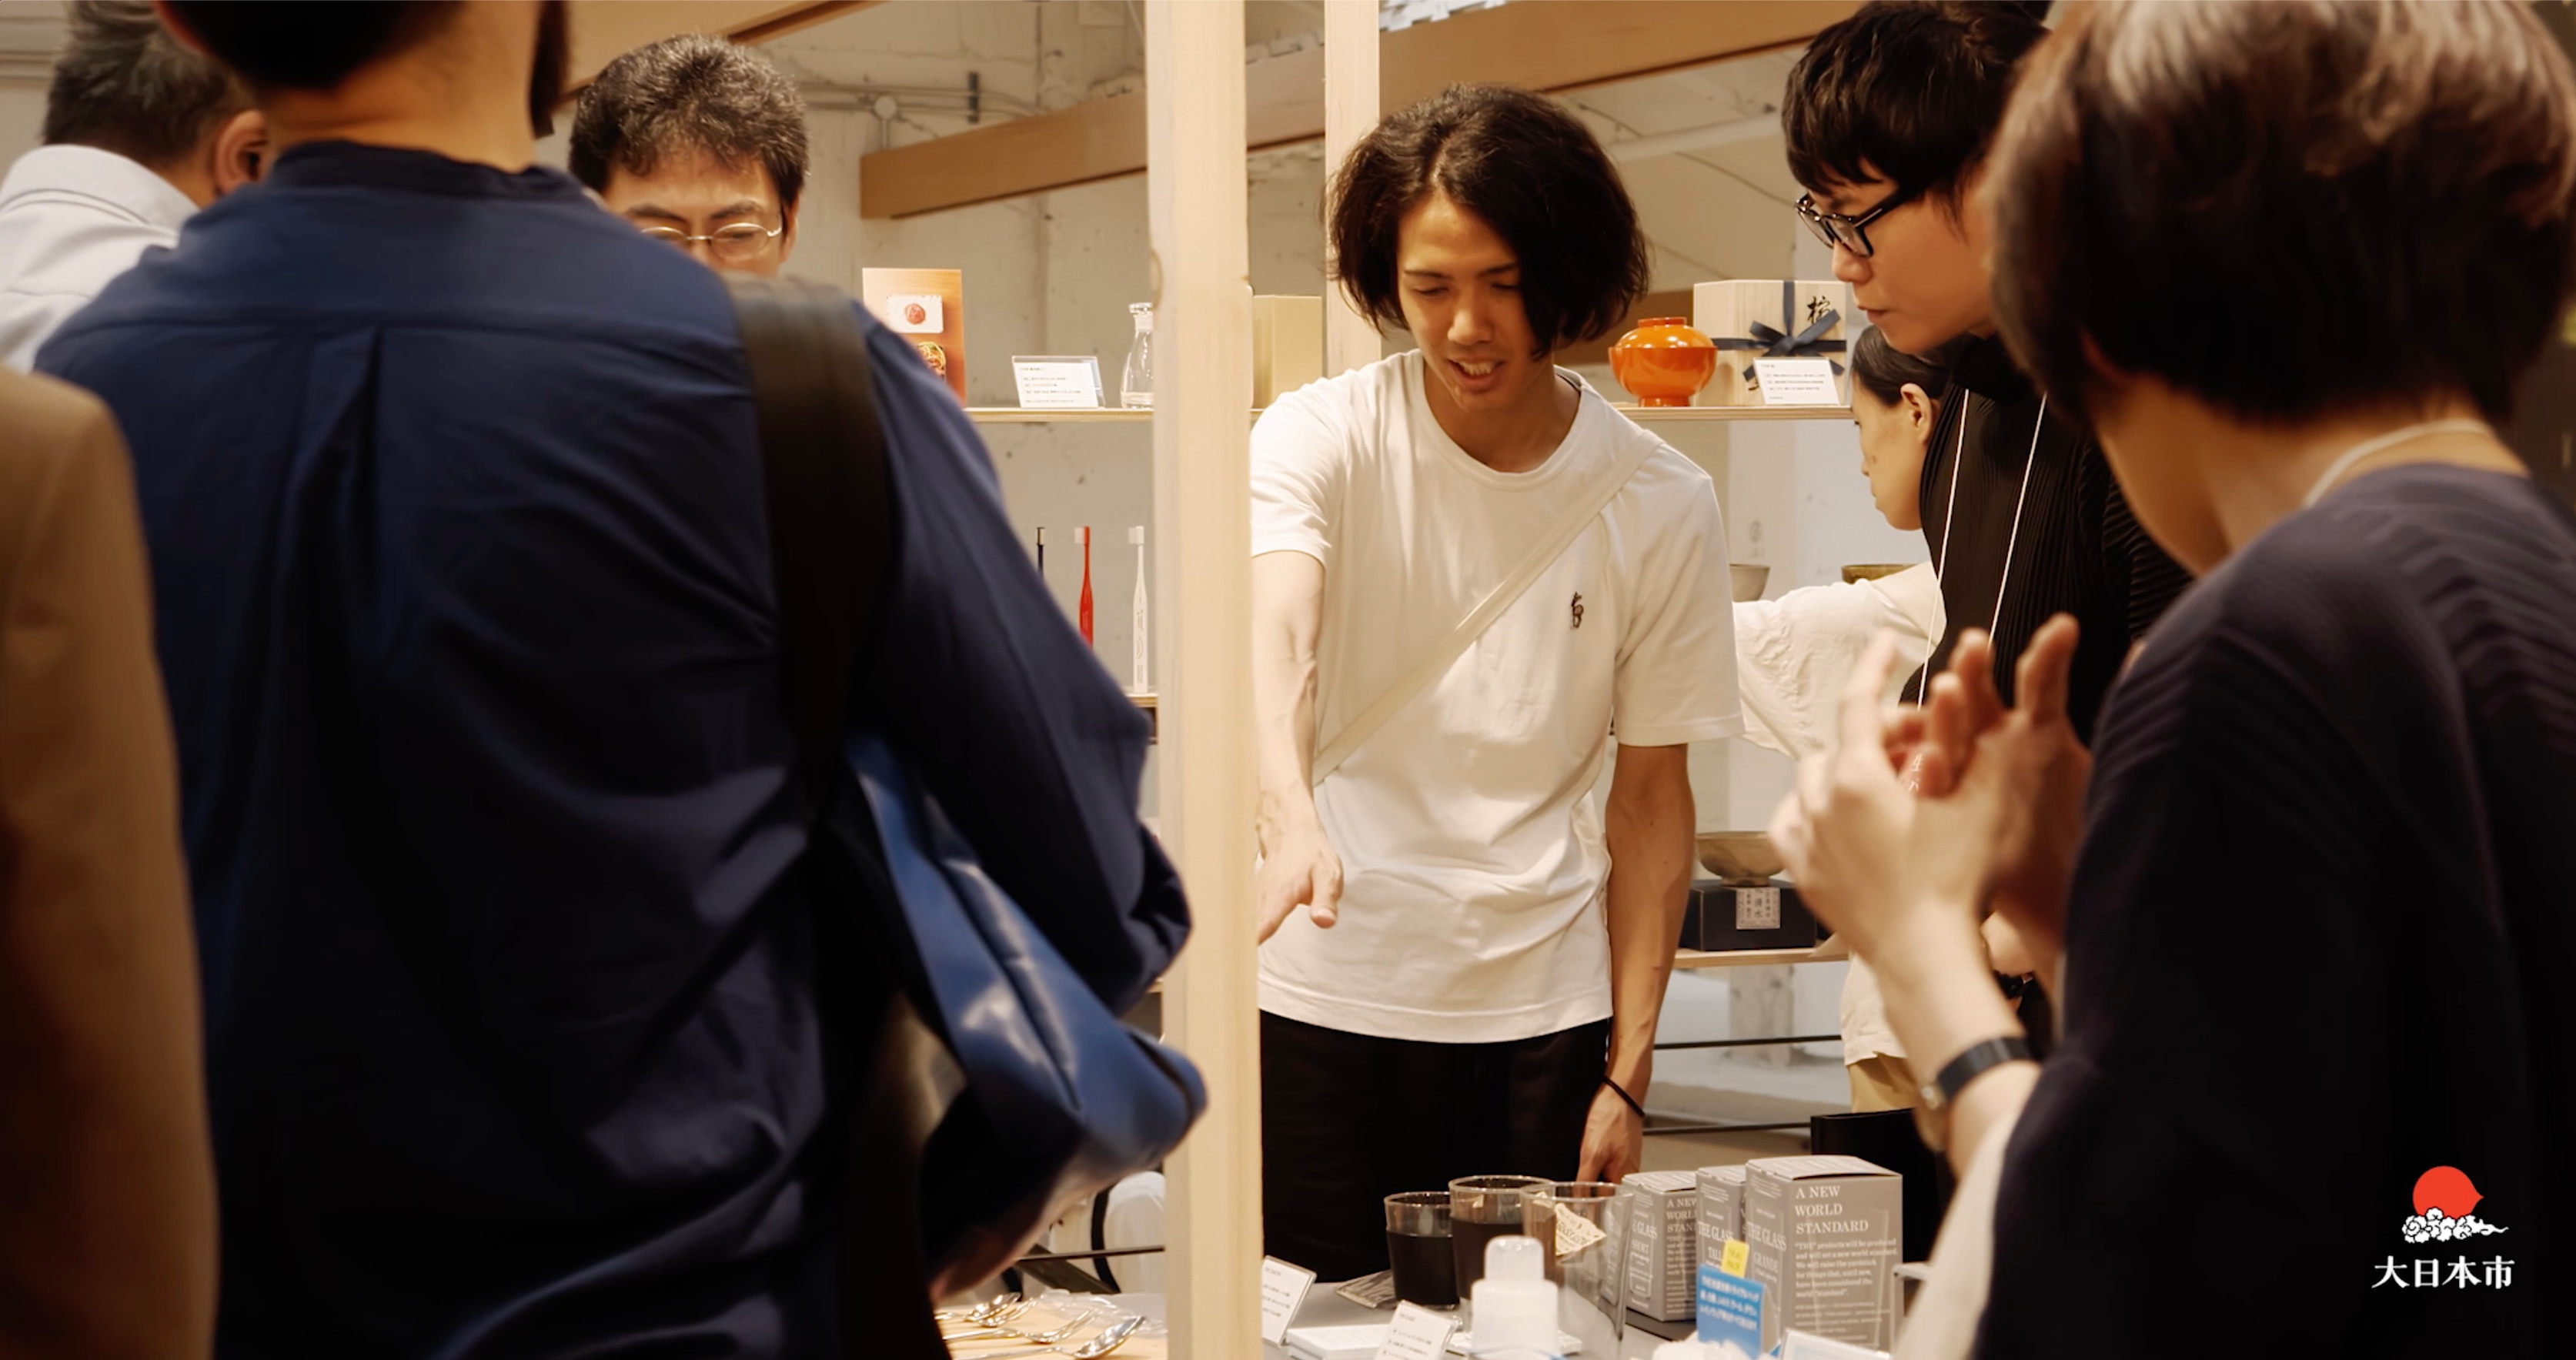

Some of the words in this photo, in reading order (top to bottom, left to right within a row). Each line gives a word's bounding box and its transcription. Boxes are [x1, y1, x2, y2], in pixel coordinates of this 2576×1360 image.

[1796, 1187, 1806, 1199] A
[1809, 1185, 1840, 1198] NEW
[1666, 1198, 1674, 1208] A
[1795, 1203, 1843, 1217] WORLD
[1666, 1210, 1696, 1220] WORL
[1667, 1222, 1696, 1233] STAN
[1697, 1220, 1711, 1238] THE
[1795, 1219, 1869, 1235] STANDARD
[1746, 1221, 1762, 1241] THE
[1762, 1227, 1787, 1252] GLASS
